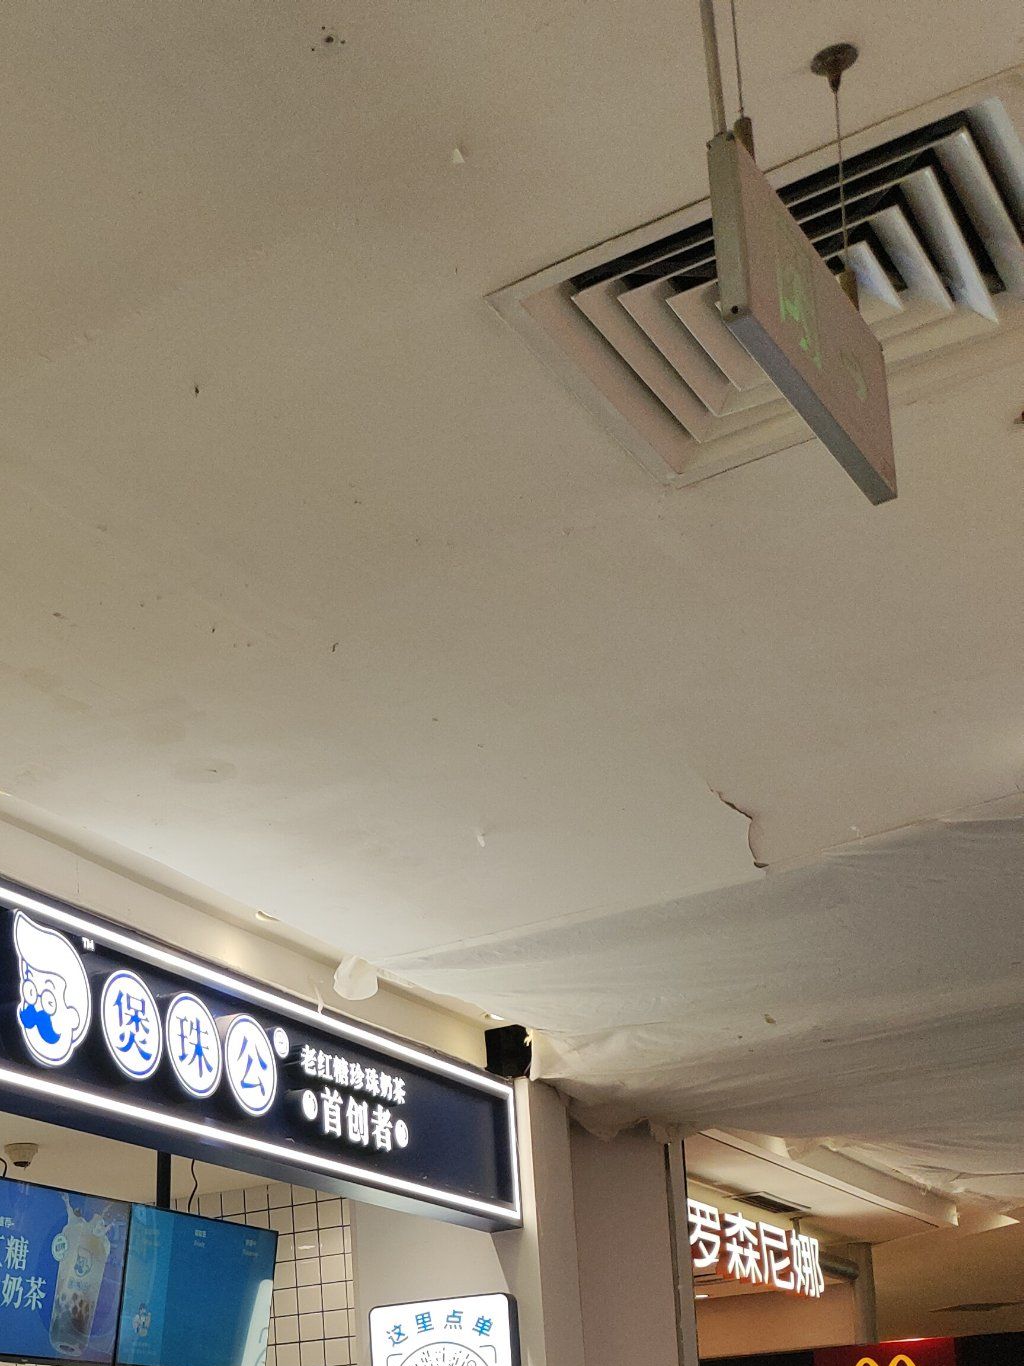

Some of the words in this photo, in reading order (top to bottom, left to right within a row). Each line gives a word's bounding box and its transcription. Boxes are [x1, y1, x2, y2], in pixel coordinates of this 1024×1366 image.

[106, 979, 274, 1107] 煲珠公
[300, 1044, 406, 1104] 老红糖珍珠奶茶
[321, 1089, 394, 1152] 首创者
[387, 1309, 494, 1346] 这里点单
